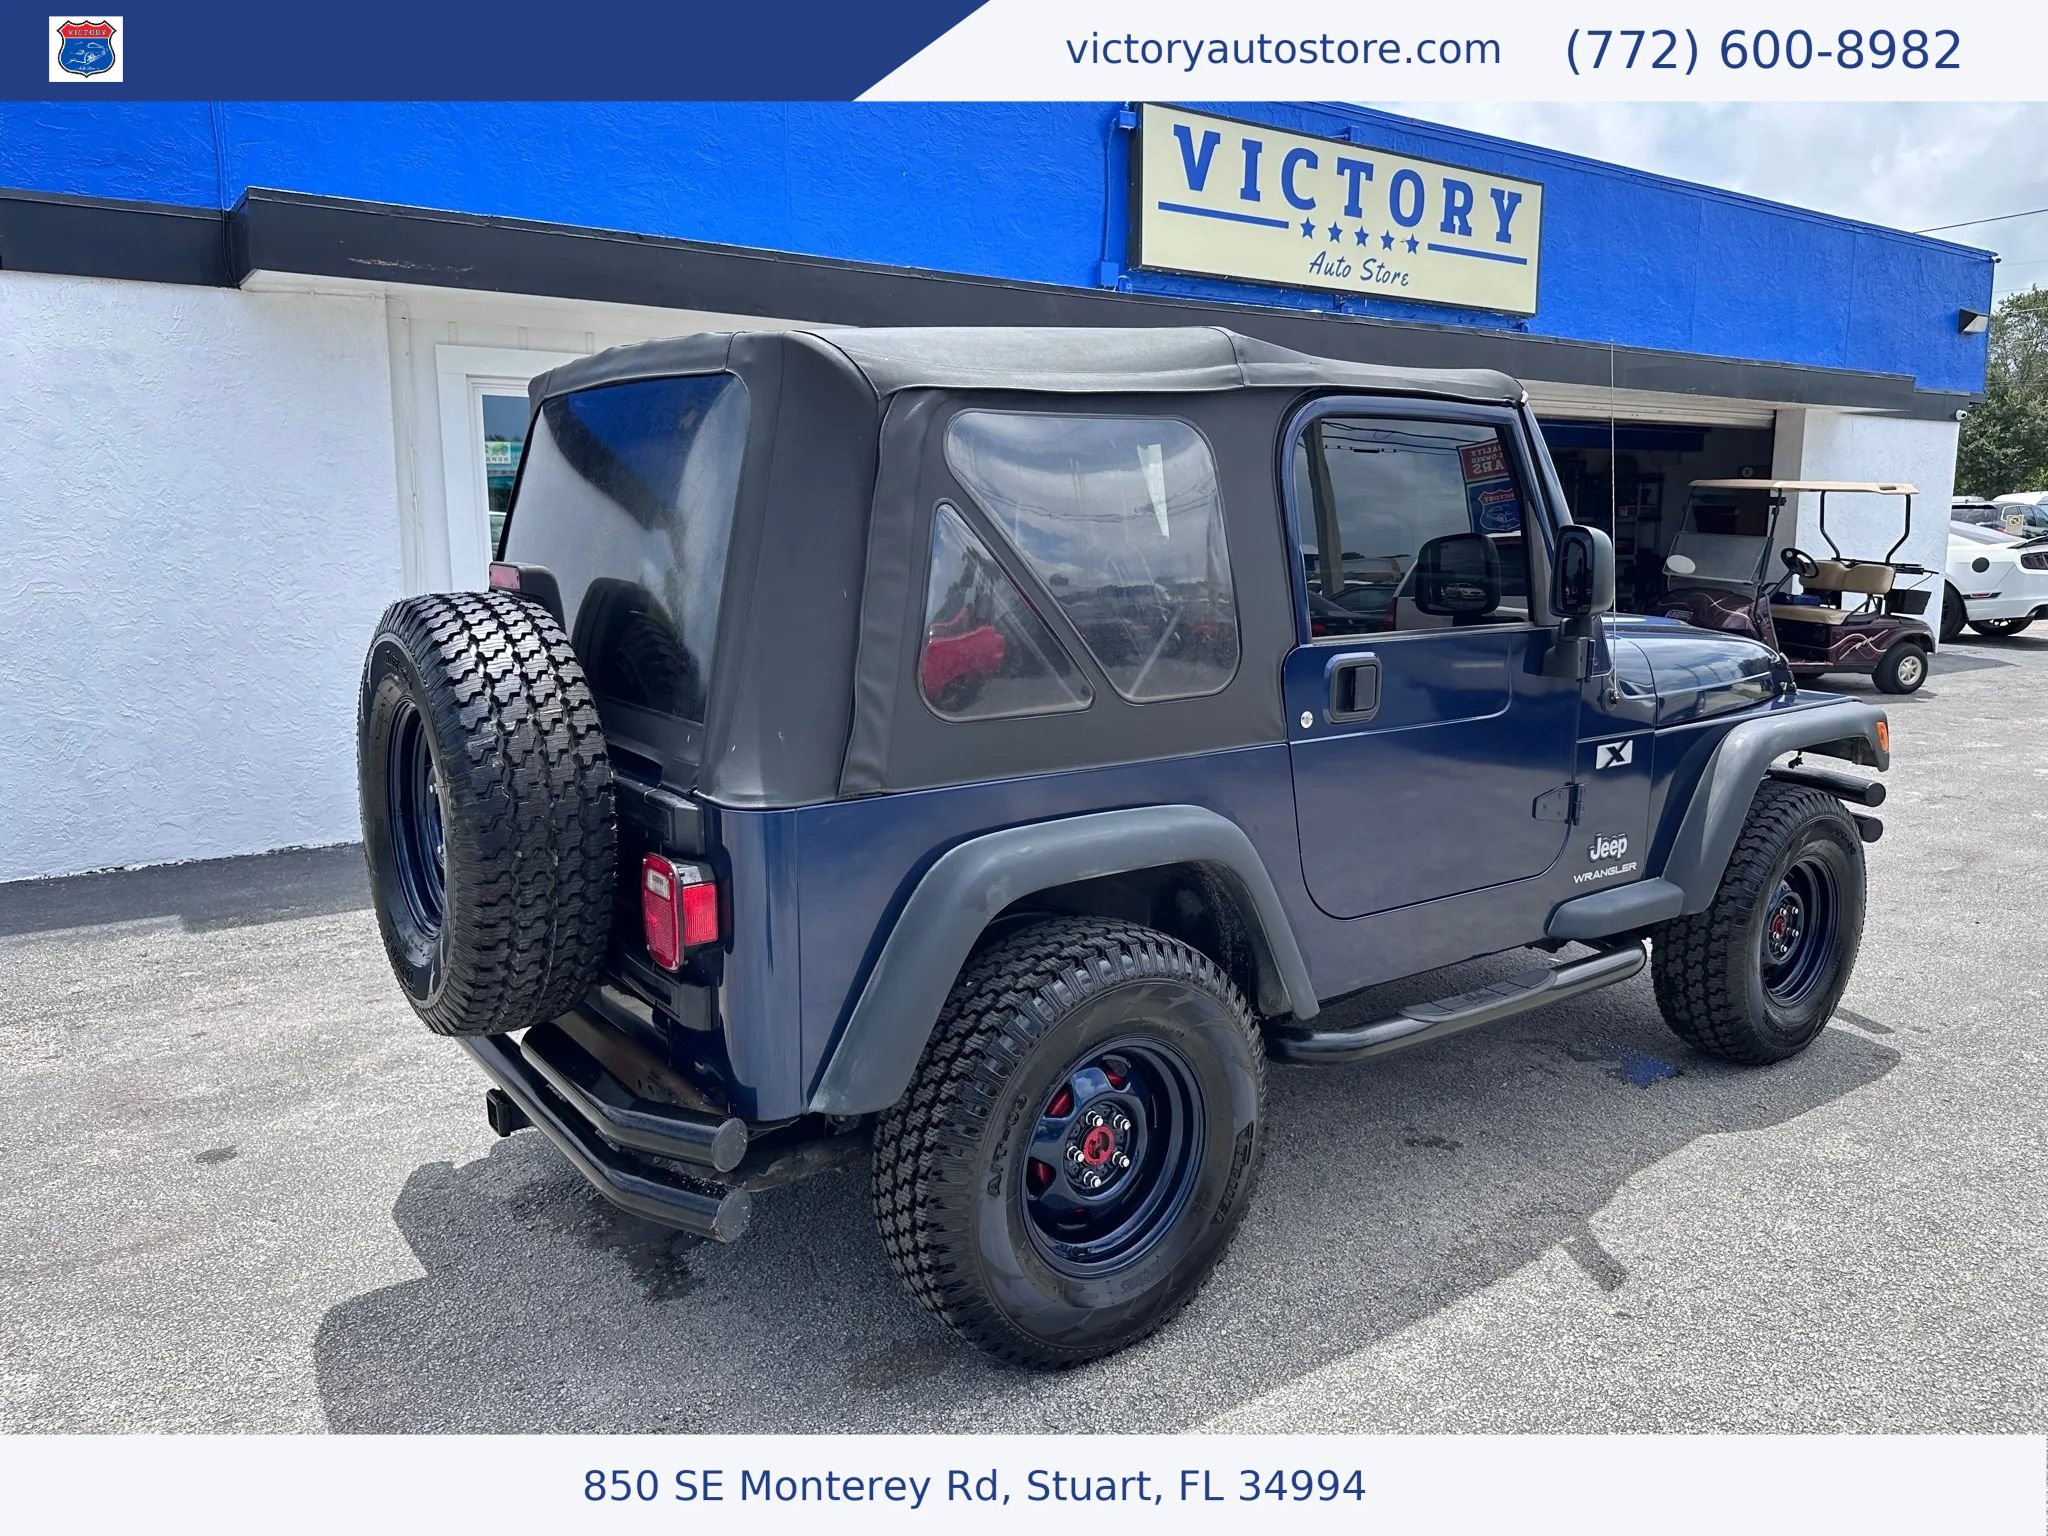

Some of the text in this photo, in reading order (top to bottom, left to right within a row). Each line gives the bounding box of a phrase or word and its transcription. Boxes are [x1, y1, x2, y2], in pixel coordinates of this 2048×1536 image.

[1173, 124, 1522, 244] VICTORY
[1309, 250, 1410, 288] Auto Store
[1589, 832, 1628, 861] Jeep
[1573, 861, 1638, 884] WRANGLER
